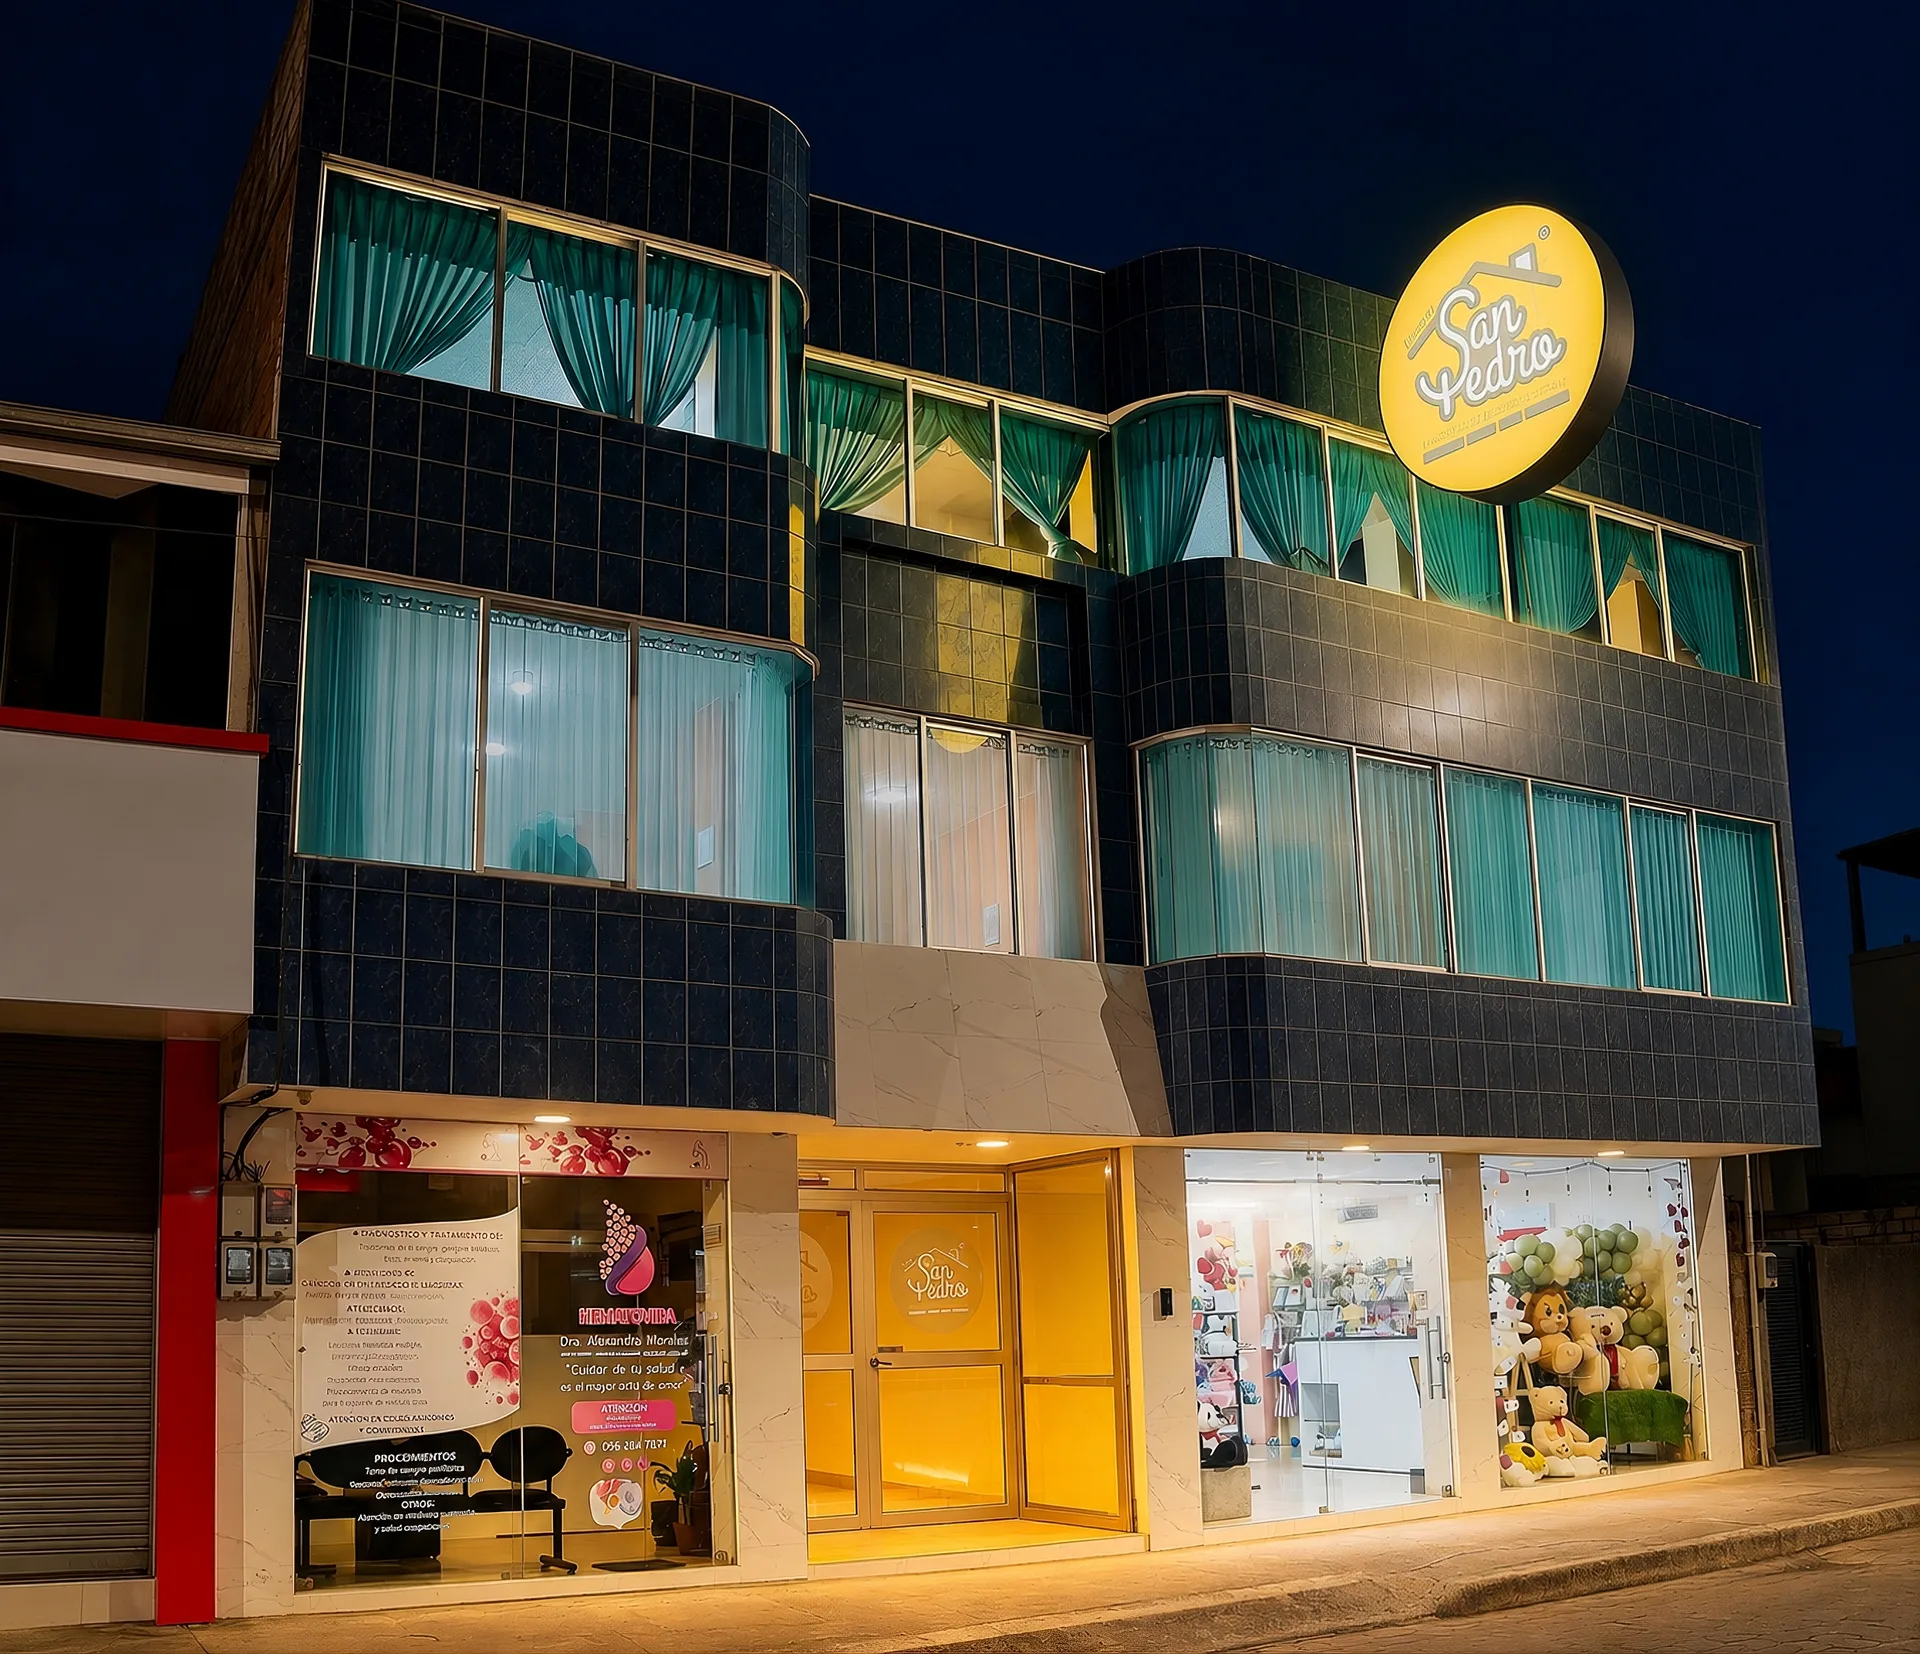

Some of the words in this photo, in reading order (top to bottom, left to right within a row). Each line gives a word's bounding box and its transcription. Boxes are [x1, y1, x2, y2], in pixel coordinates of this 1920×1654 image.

[1437, 284, 1527, 352] San
[1416, 327, 1567, 421] Pedro
[907, 1279, 969, 1302] Pedro
[917, 1253, 954, 1281] San
